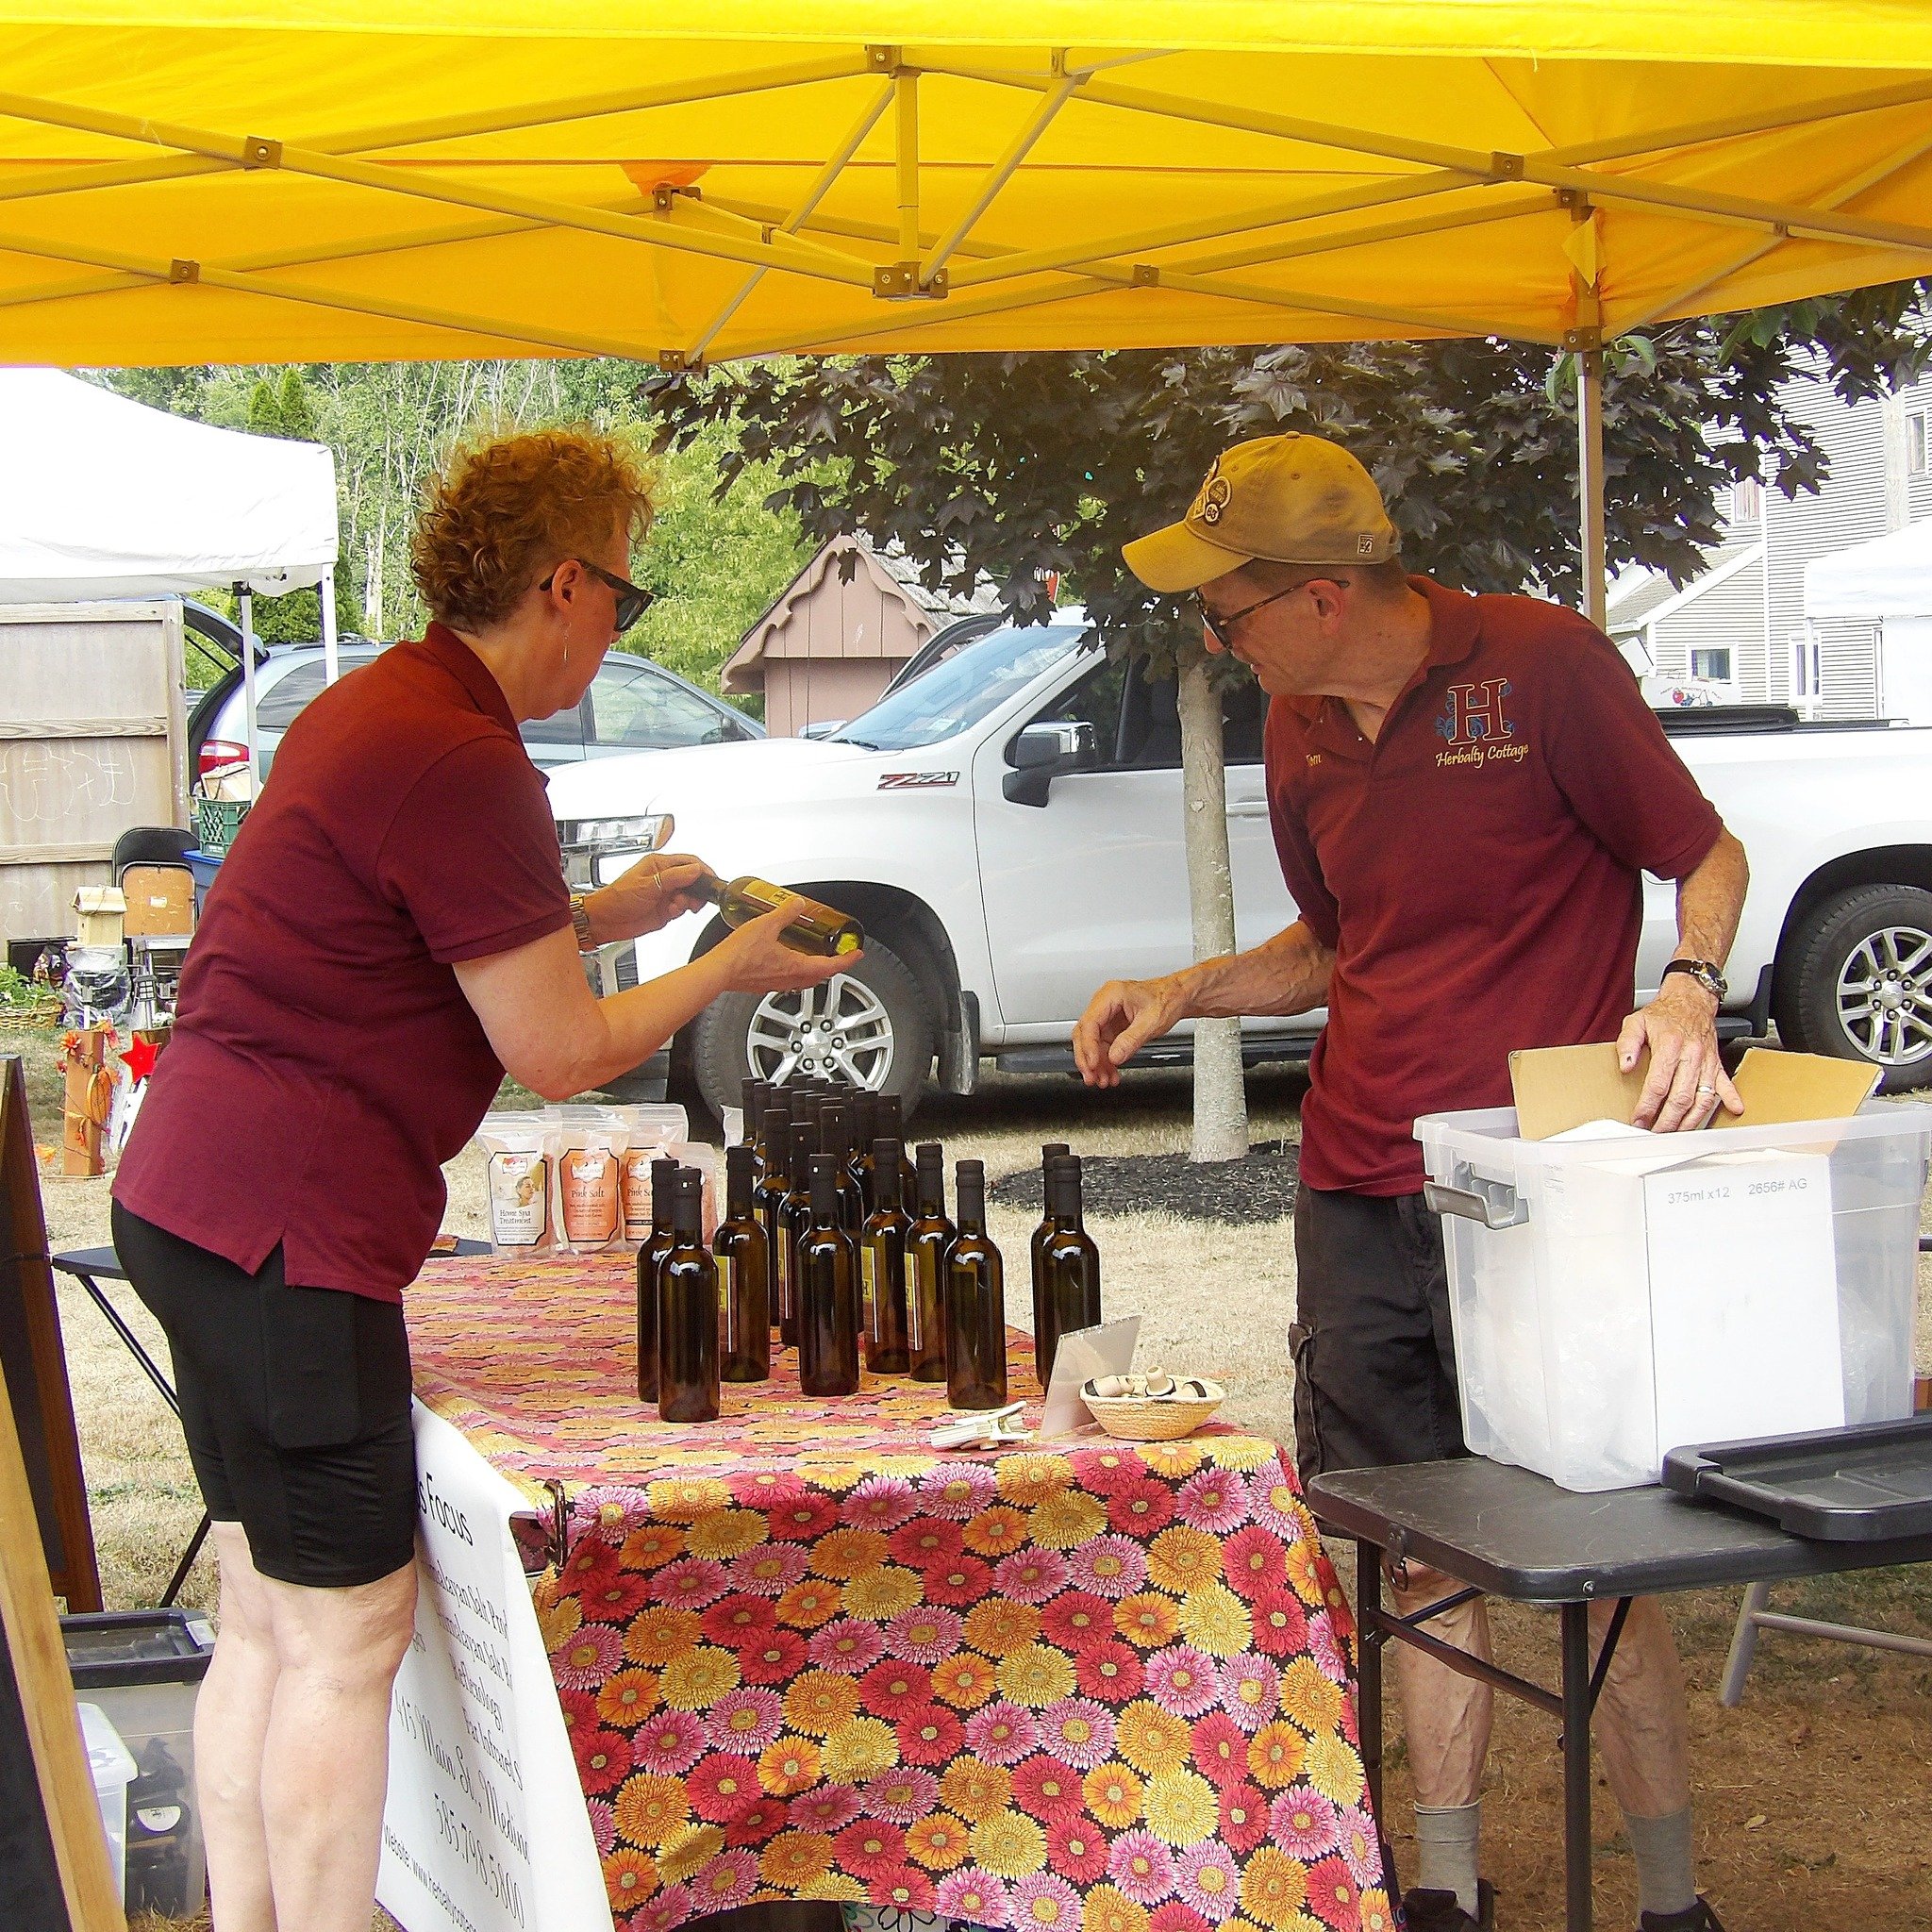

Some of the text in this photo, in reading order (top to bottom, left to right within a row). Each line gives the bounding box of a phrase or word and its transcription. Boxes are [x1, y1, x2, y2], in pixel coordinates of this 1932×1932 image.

[1436, 743, 1529, 769] Herbalty Cottage
[571, 1185, 605, 1198] Pink Salt
[1667, 1177, 1808, 1205] 375ml x12 2656# AG
[425, 1471, 474, 1547] Focus
[433, 1791, 525, 1929] 585.798.5800
